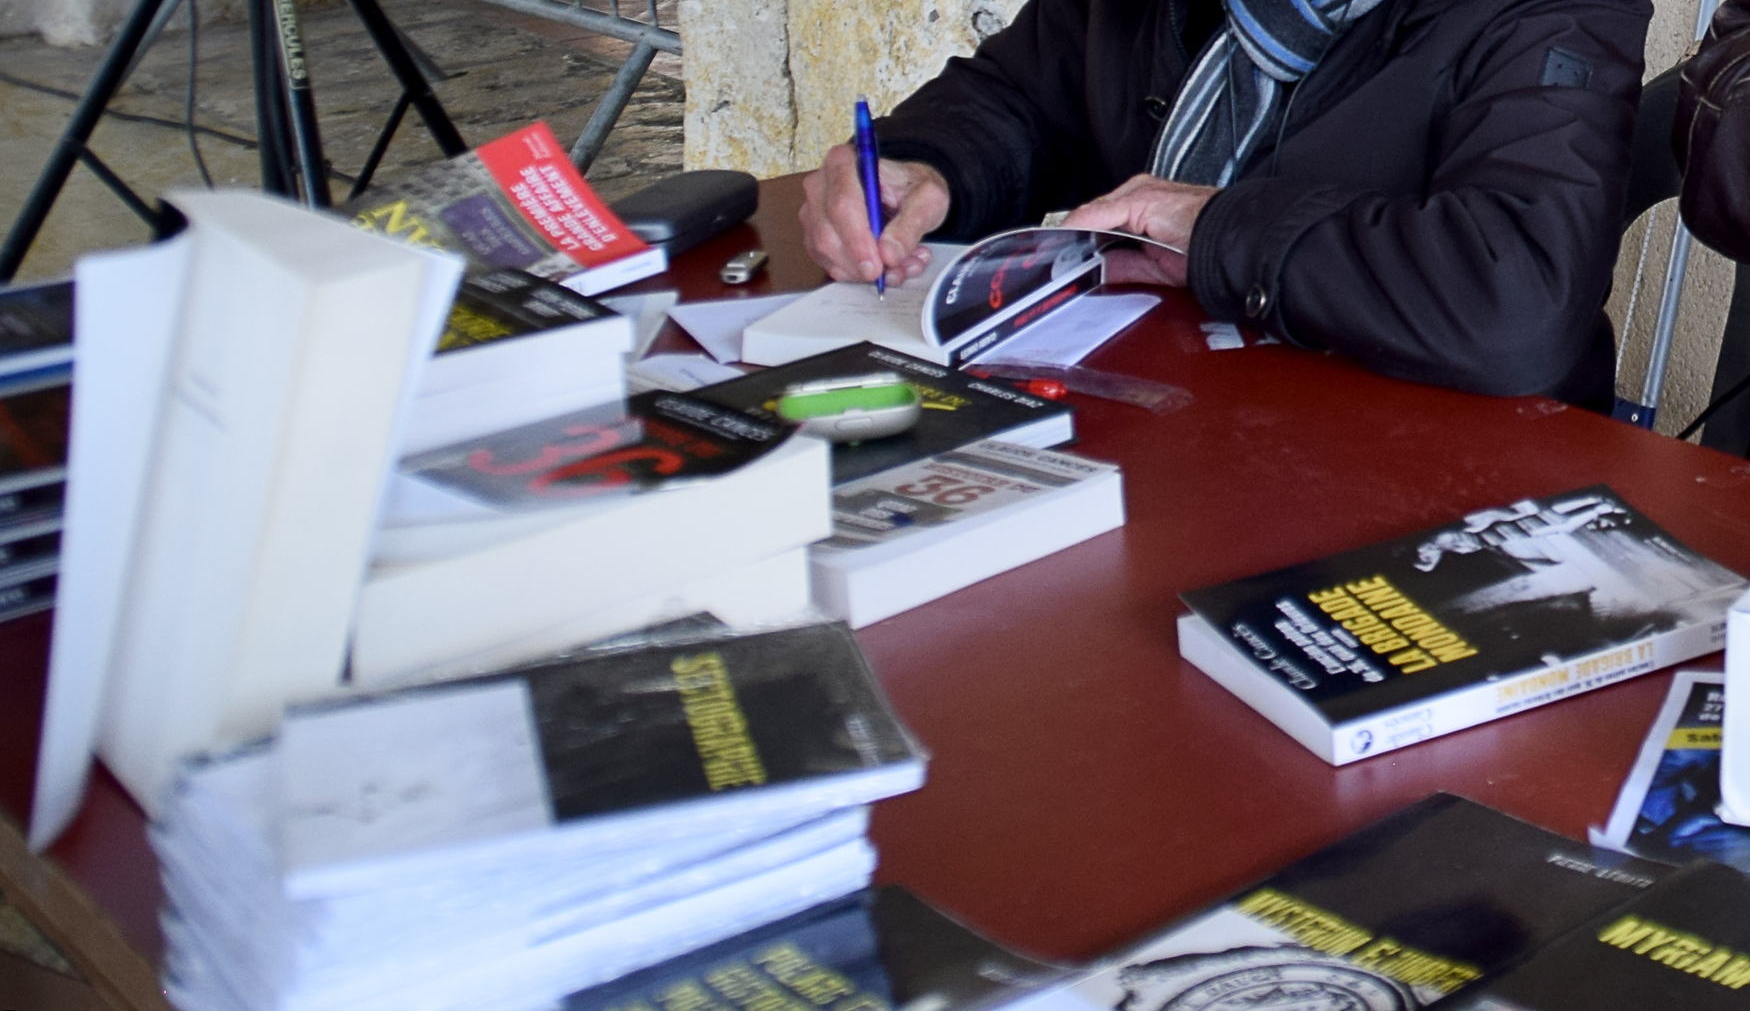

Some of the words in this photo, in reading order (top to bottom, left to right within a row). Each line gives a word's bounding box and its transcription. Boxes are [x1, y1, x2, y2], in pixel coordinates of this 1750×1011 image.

[519, 164, 565, 214] AFFAIRE
[558, 213, 606, 252] GRANDE
[1308, 586, 1410, 655] BRIGADE
[1346, 575, 1480, 663] MONDAINE
[1387, 647, 1439, 675] LA
